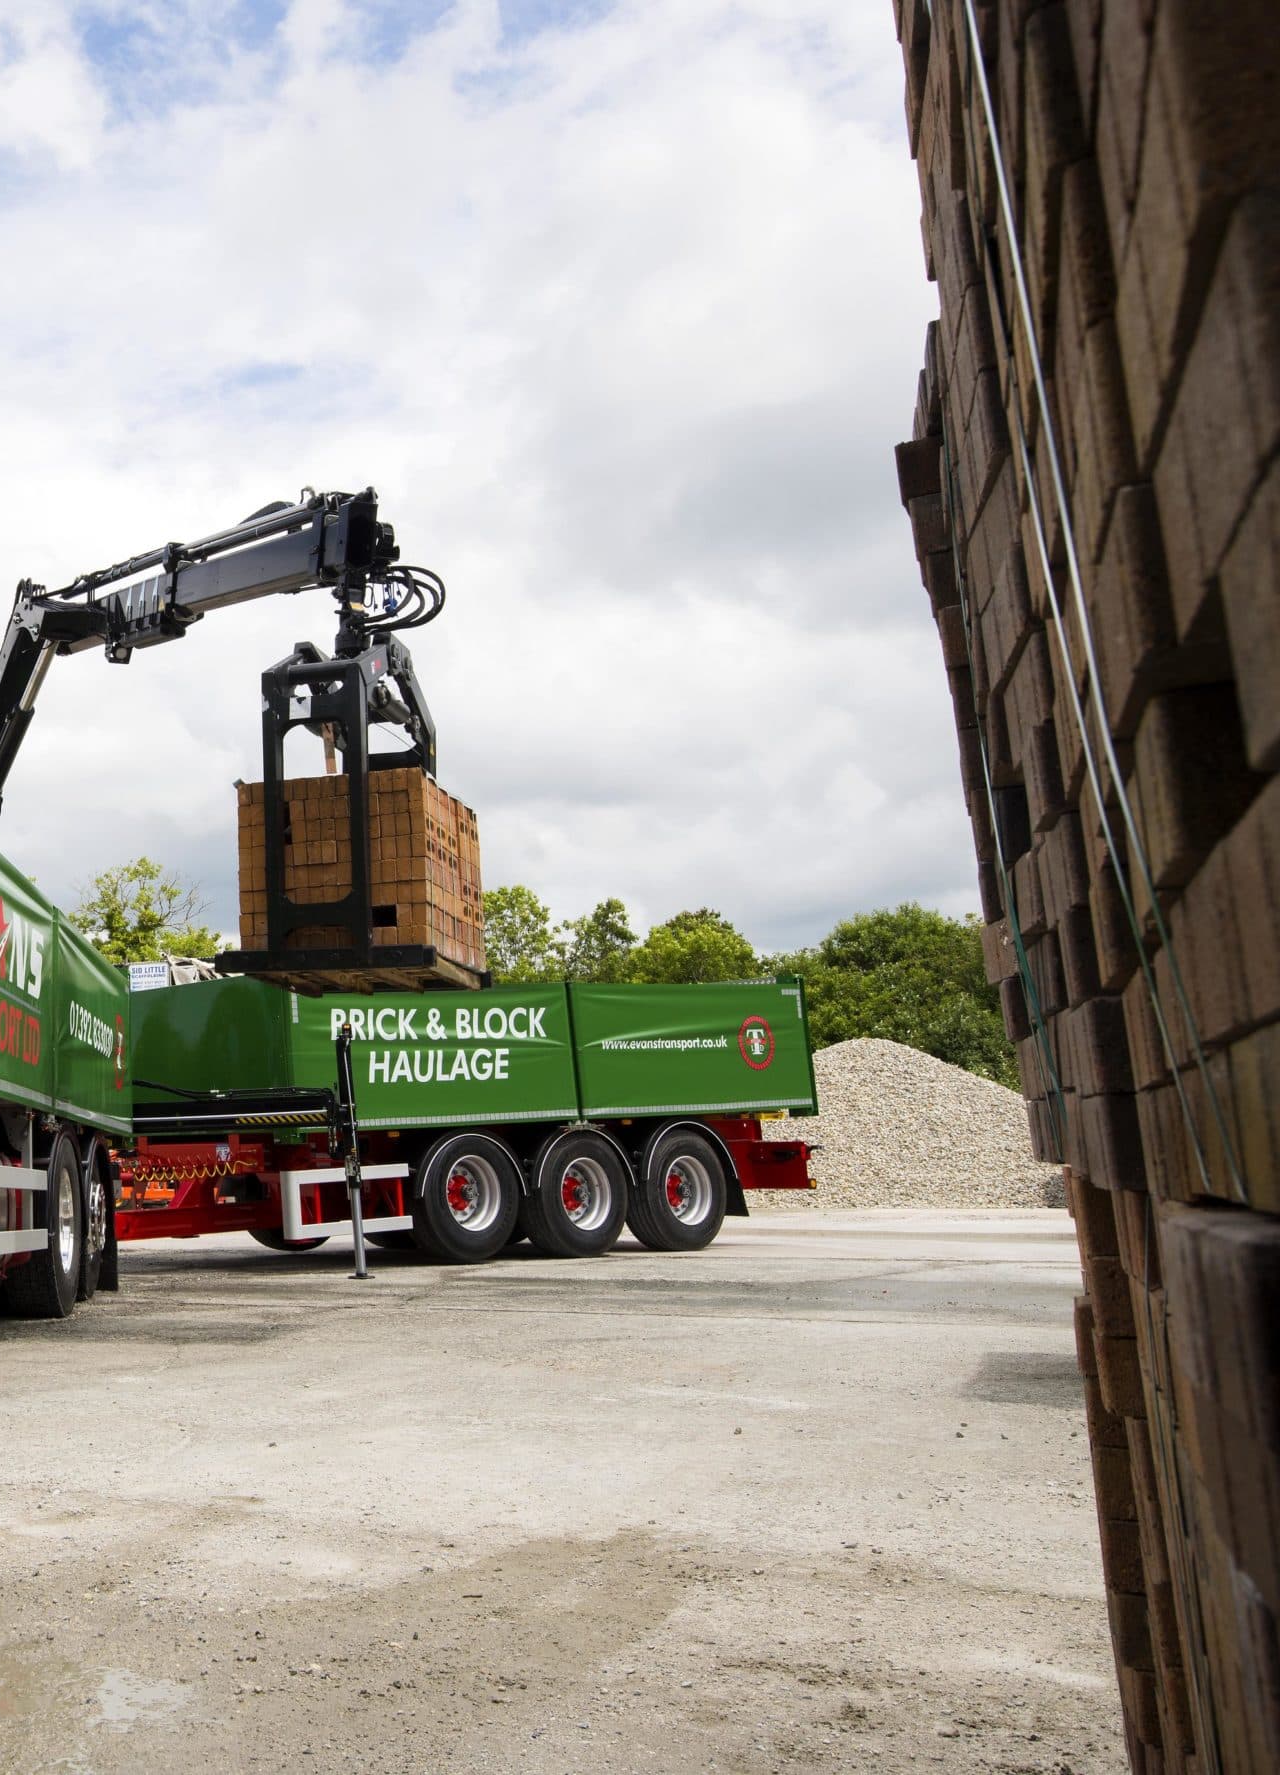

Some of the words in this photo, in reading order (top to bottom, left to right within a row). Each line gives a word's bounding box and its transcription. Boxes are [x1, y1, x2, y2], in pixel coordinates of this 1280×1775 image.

[23, 1013, 41, 1067] LTD
[69, 1000, 92, 1046] 01392
[93, 1016, 114, 1058] 833030
[330, 1007, 418, 1041] BRICK
[426, 1007, 448, 1041] &
[456, 1007, 547, 1040] BLOCK
[601, 1035, 727, 1052] www.evanstransport.co.uk
[368, 1048, 510, 1084] HAULAGE
